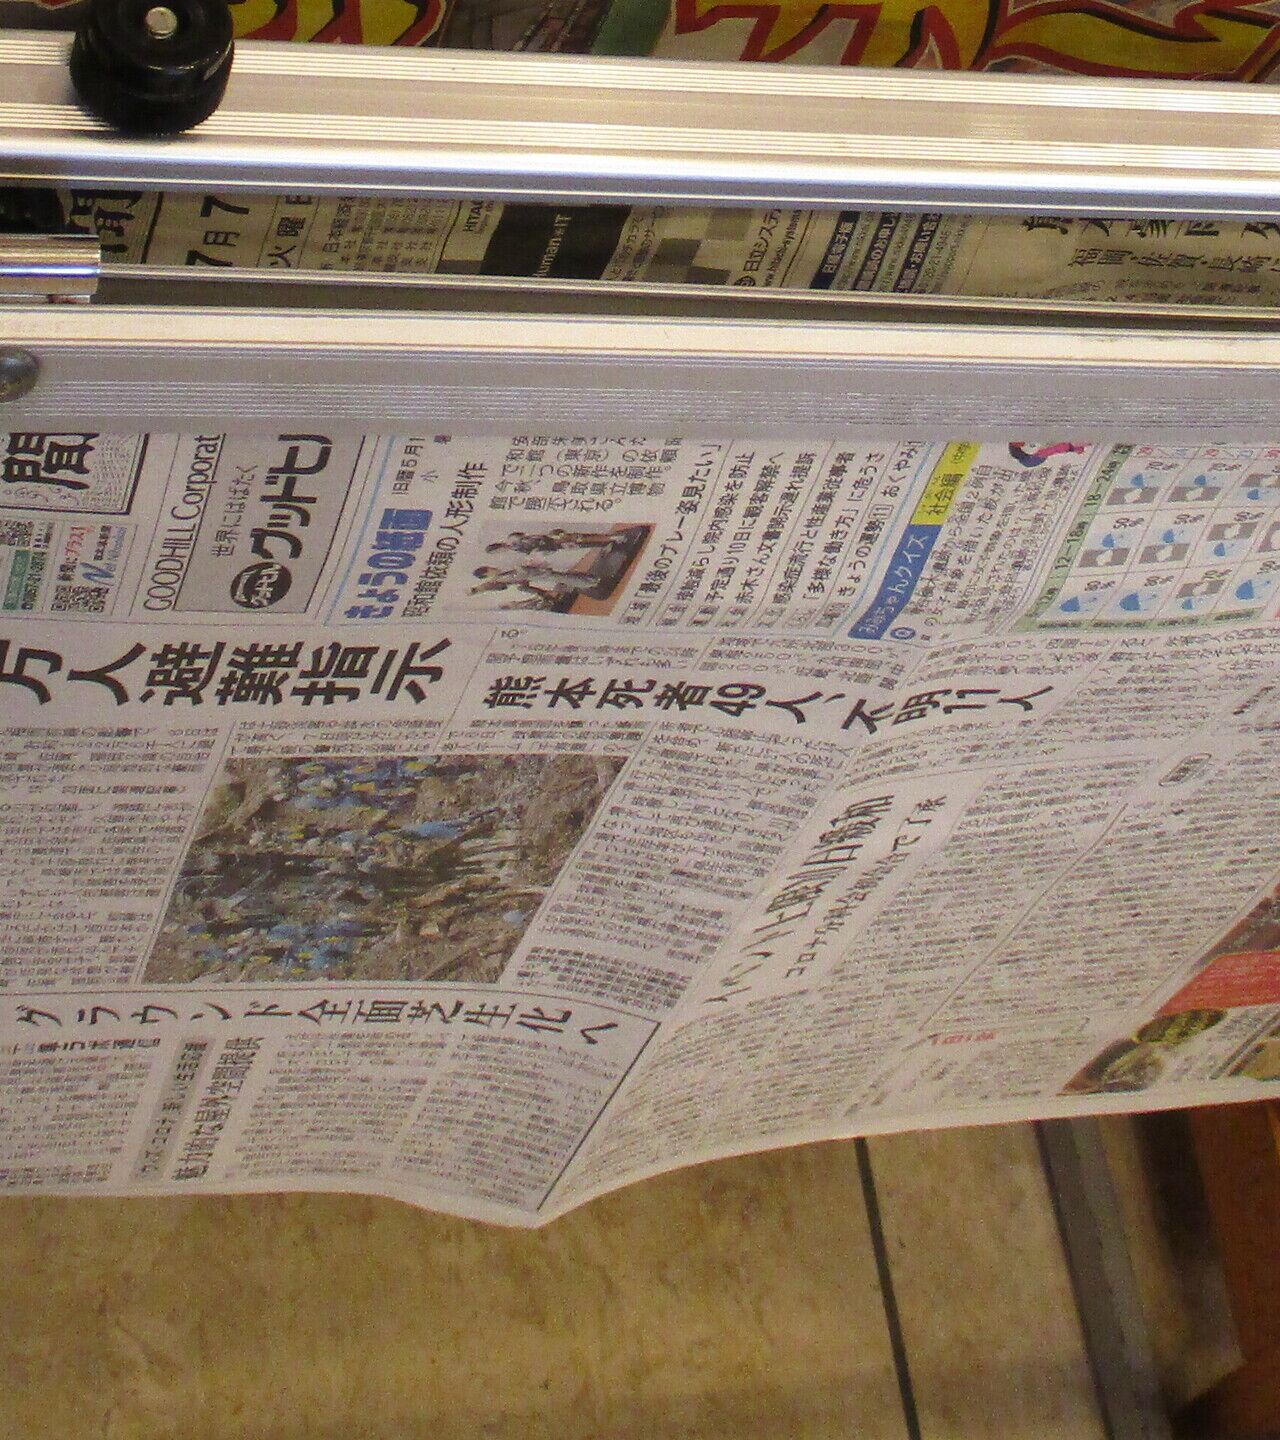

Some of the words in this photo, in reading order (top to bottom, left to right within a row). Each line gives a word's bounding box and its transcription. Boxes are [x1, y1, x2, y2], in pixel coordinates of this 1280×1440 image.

[142, 523, 196, 613] GOODHILL
[171, 433, 221, 521] Corporat
[212, 464, 258, 558] 世界にはばたく
[342, 507, 434, 619] きょうの紙面
[400, 461, 488, 619] 昭和館依頼の人形制作
[631, 442, 722, 600] 「最後のプレー姿見たい」
[674, 452, 755, 603] 接触減らし院内感染を防止
[704, 452, 785, 603] 予定通り10日に観客解禁へ
[733, 452, 816, 605] 赤木さん文書開示遅れ提訴
[772, 450, 856, 606] 感染症流行と性産業従事者
[801, 450, 886, 602] 「多様な働き方」に危うさ
[928, 472, 964, 515] 社会編
[482, 672, 1054, 737] 熊本死者49人、不明11人
[14, 998, 619, 1048] グラウンド全面芝生化へ
